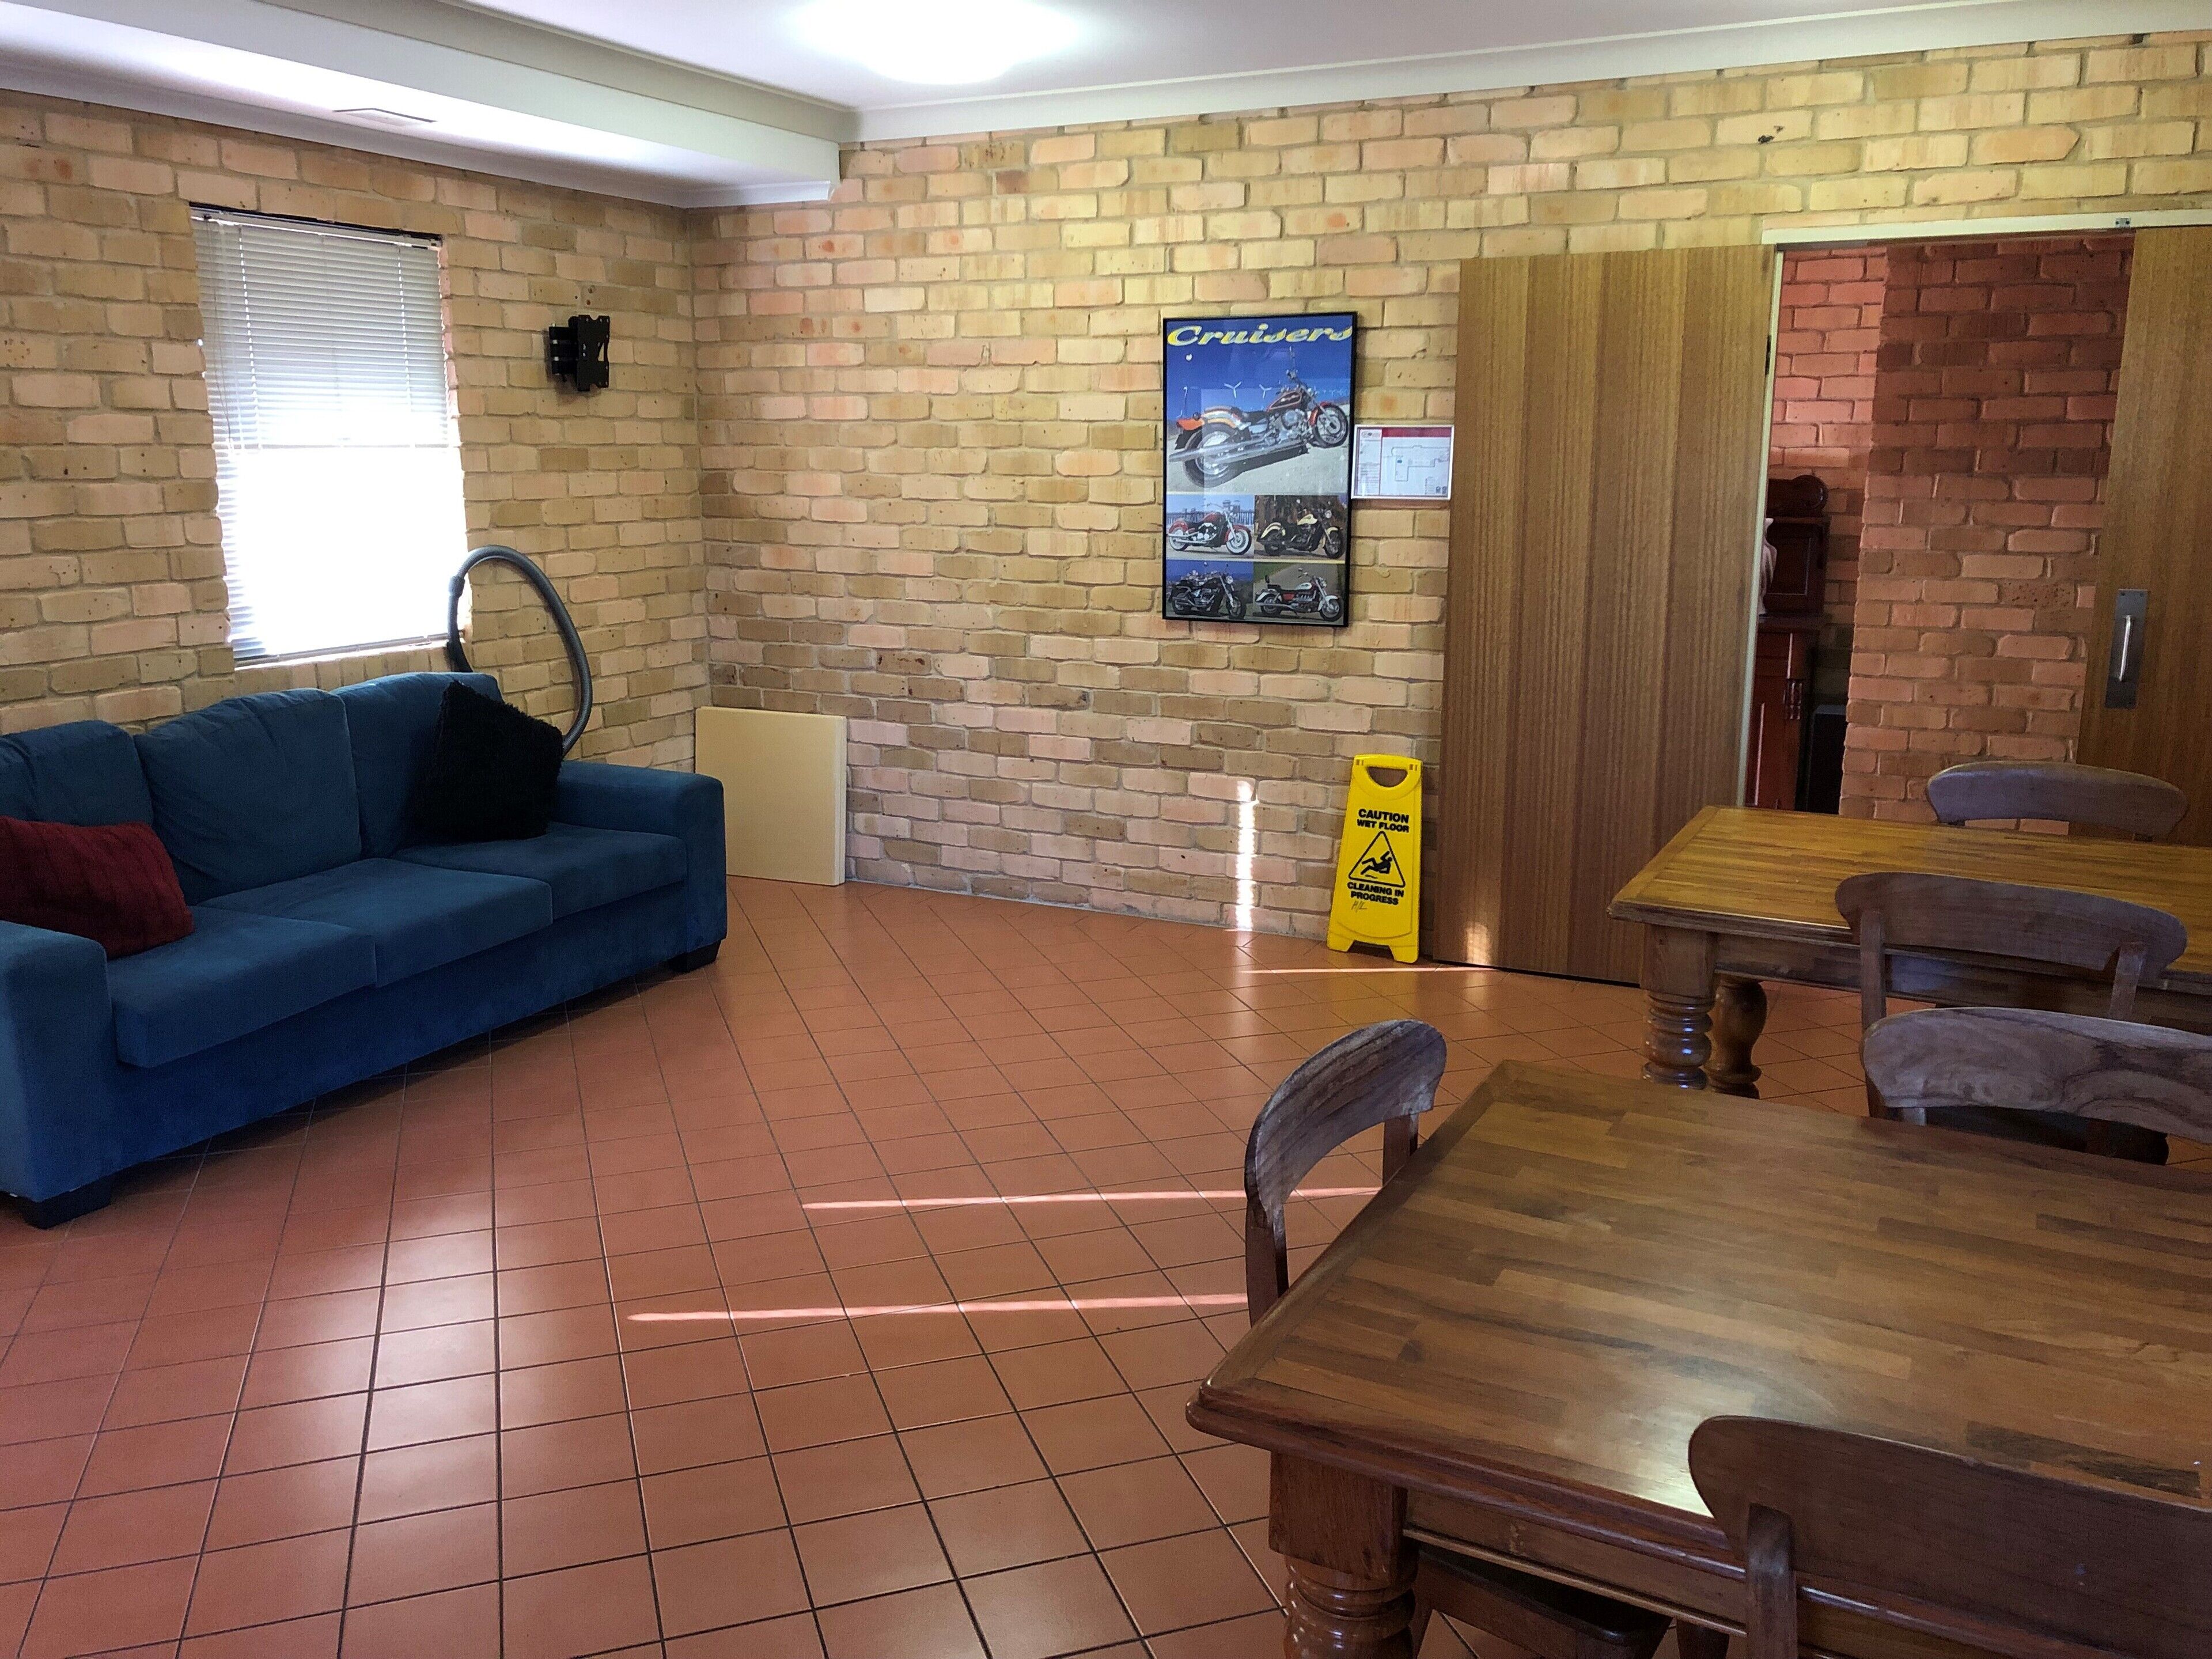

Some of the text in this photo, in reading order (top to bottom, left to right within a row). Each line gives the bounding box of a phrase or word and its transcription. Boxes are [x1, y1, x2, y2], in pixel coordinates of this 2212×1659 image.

[1166, 323, 1353, 346] Cruisers
[1358, 808, 1410, 824] CAUTION
[1357, 819, 1410, 833] WET FLOOR
[1347, 882, 1404, 897] CLEANING IN
[1351, 891, 1399, 906] PROGRESS
